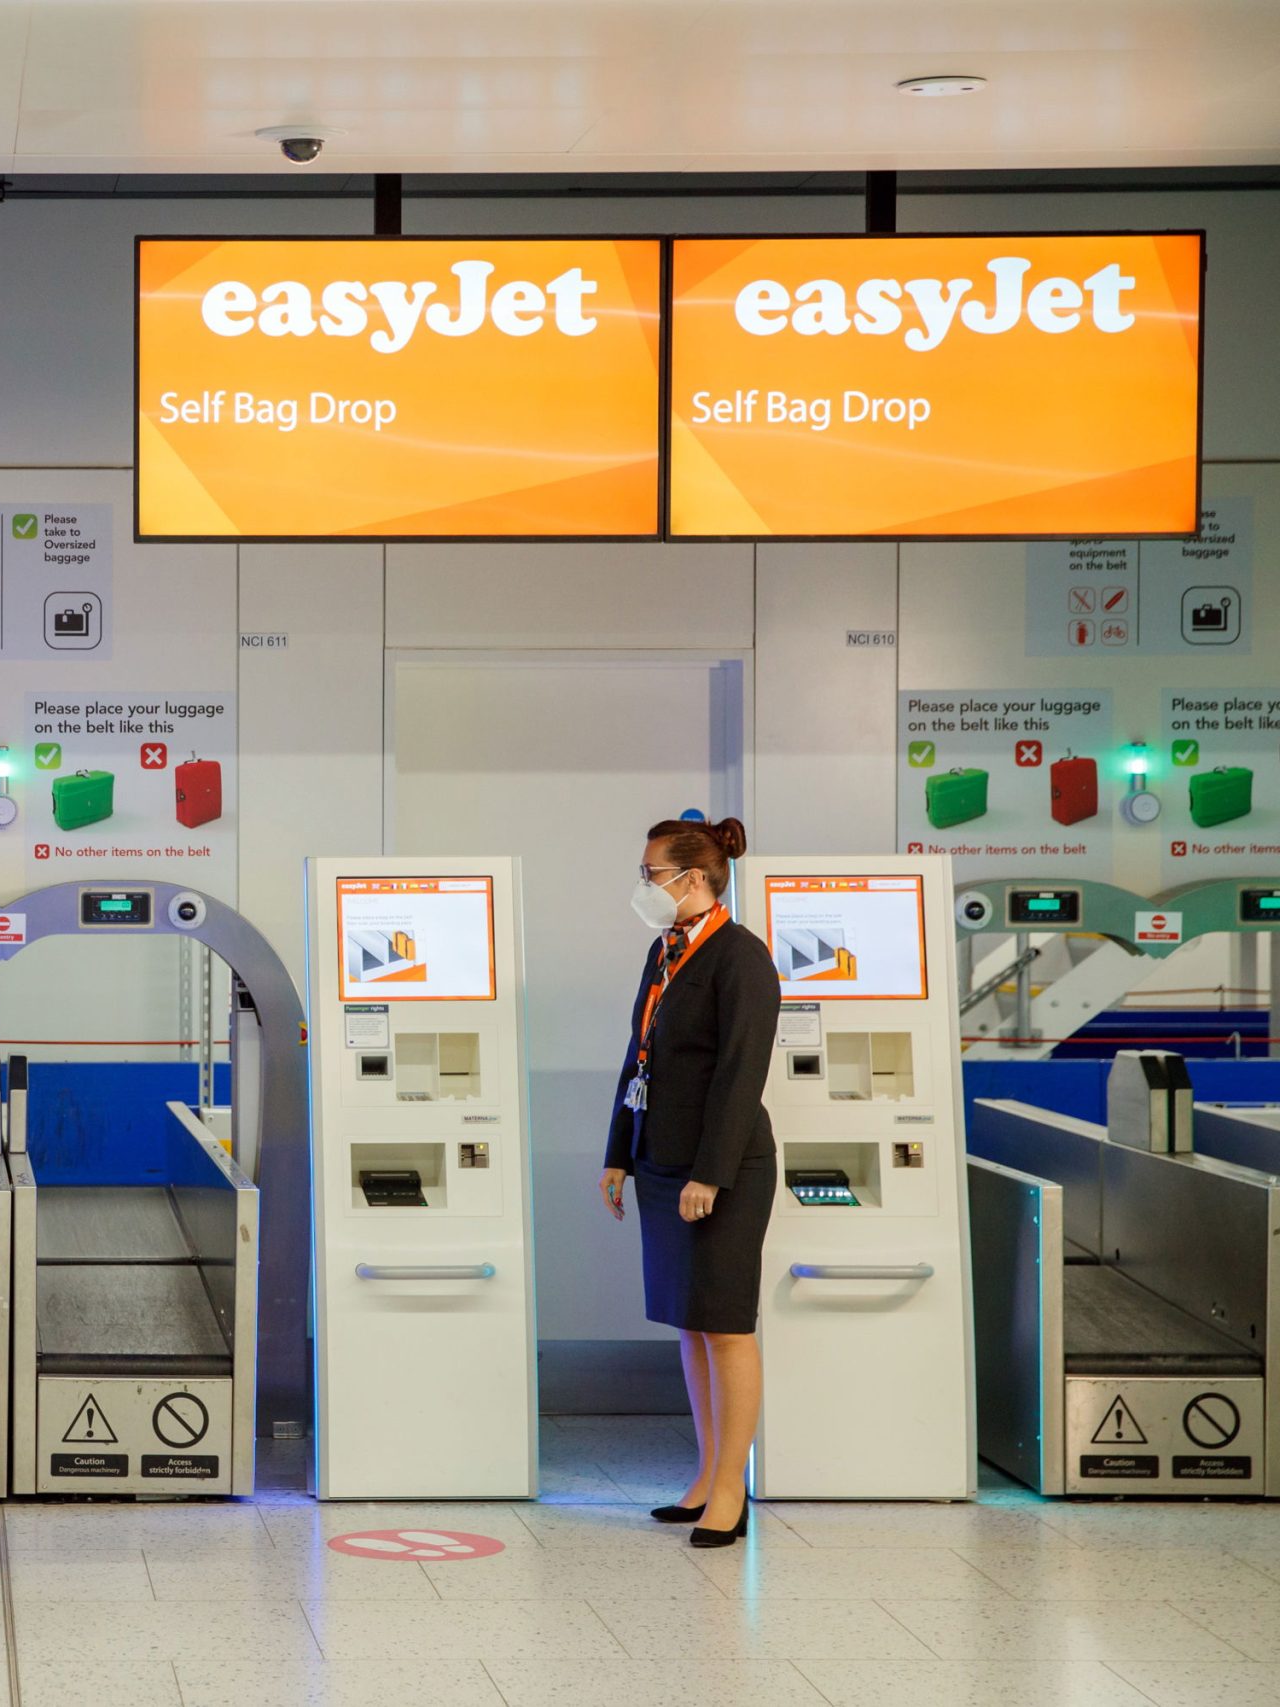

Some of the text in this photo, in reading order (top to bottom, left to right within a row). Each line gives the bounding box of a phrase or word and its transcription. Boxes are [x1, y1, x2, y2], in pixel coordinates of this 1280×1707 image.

[202, 261, 596, 353] easyJet
[734, 258, 1135, 352] easyJet
[160, 391, 396, 432] Self Bag Drop
[692, 390, 930, 430] Self Bag Drop
[45, 514, 77, 524] Please
[44, 527, 66, 536] take
[44, 540, 95, 549] Oversized
[45, 552, 90, 564] baggage
[1070, 549, 1126, 560] equipment
[1182, 547, 1229, 559] baggage
[1086, 560, 1103, 570] the
[1106, 560, 1126, 570] belt
[242, 636, 286, 646] NCI 611
[848, 634, 894, 644] NCI 610
[35, 701, 224, 718] Please place your luggage
[909, 698, 1100, 715] Please place your luggage
[1172, 698, 1218, 710] Please
[1224, 697, 1262, 714] place
[35, 720, 174, 733] on the belt like this
[908, 717, 1049, 731] on the belt like this
[1172, 721, 1190, 730] on
[1196, 717, 1219, 729] the
[1225, 716, 1253, 729] belt
[56, 847, 72, 856] No
[76, 846, 108, 856] other
[112, 848, 143, 856] items
[165, 846, 184, 856] the
[188, 846, 210, 856] belt
[929, 845, 946, 854] No
[950, 845, 981, 854] other
[986, 846, 1017, 854] items
[1040, 844, 1059, 854] the
[1064, 844, 1086, 854] belt
[1192, 844, 1210, 854] No
[1214, 844, 1245, 854] other
[60, 1466, 89, 1474] Dangerous
